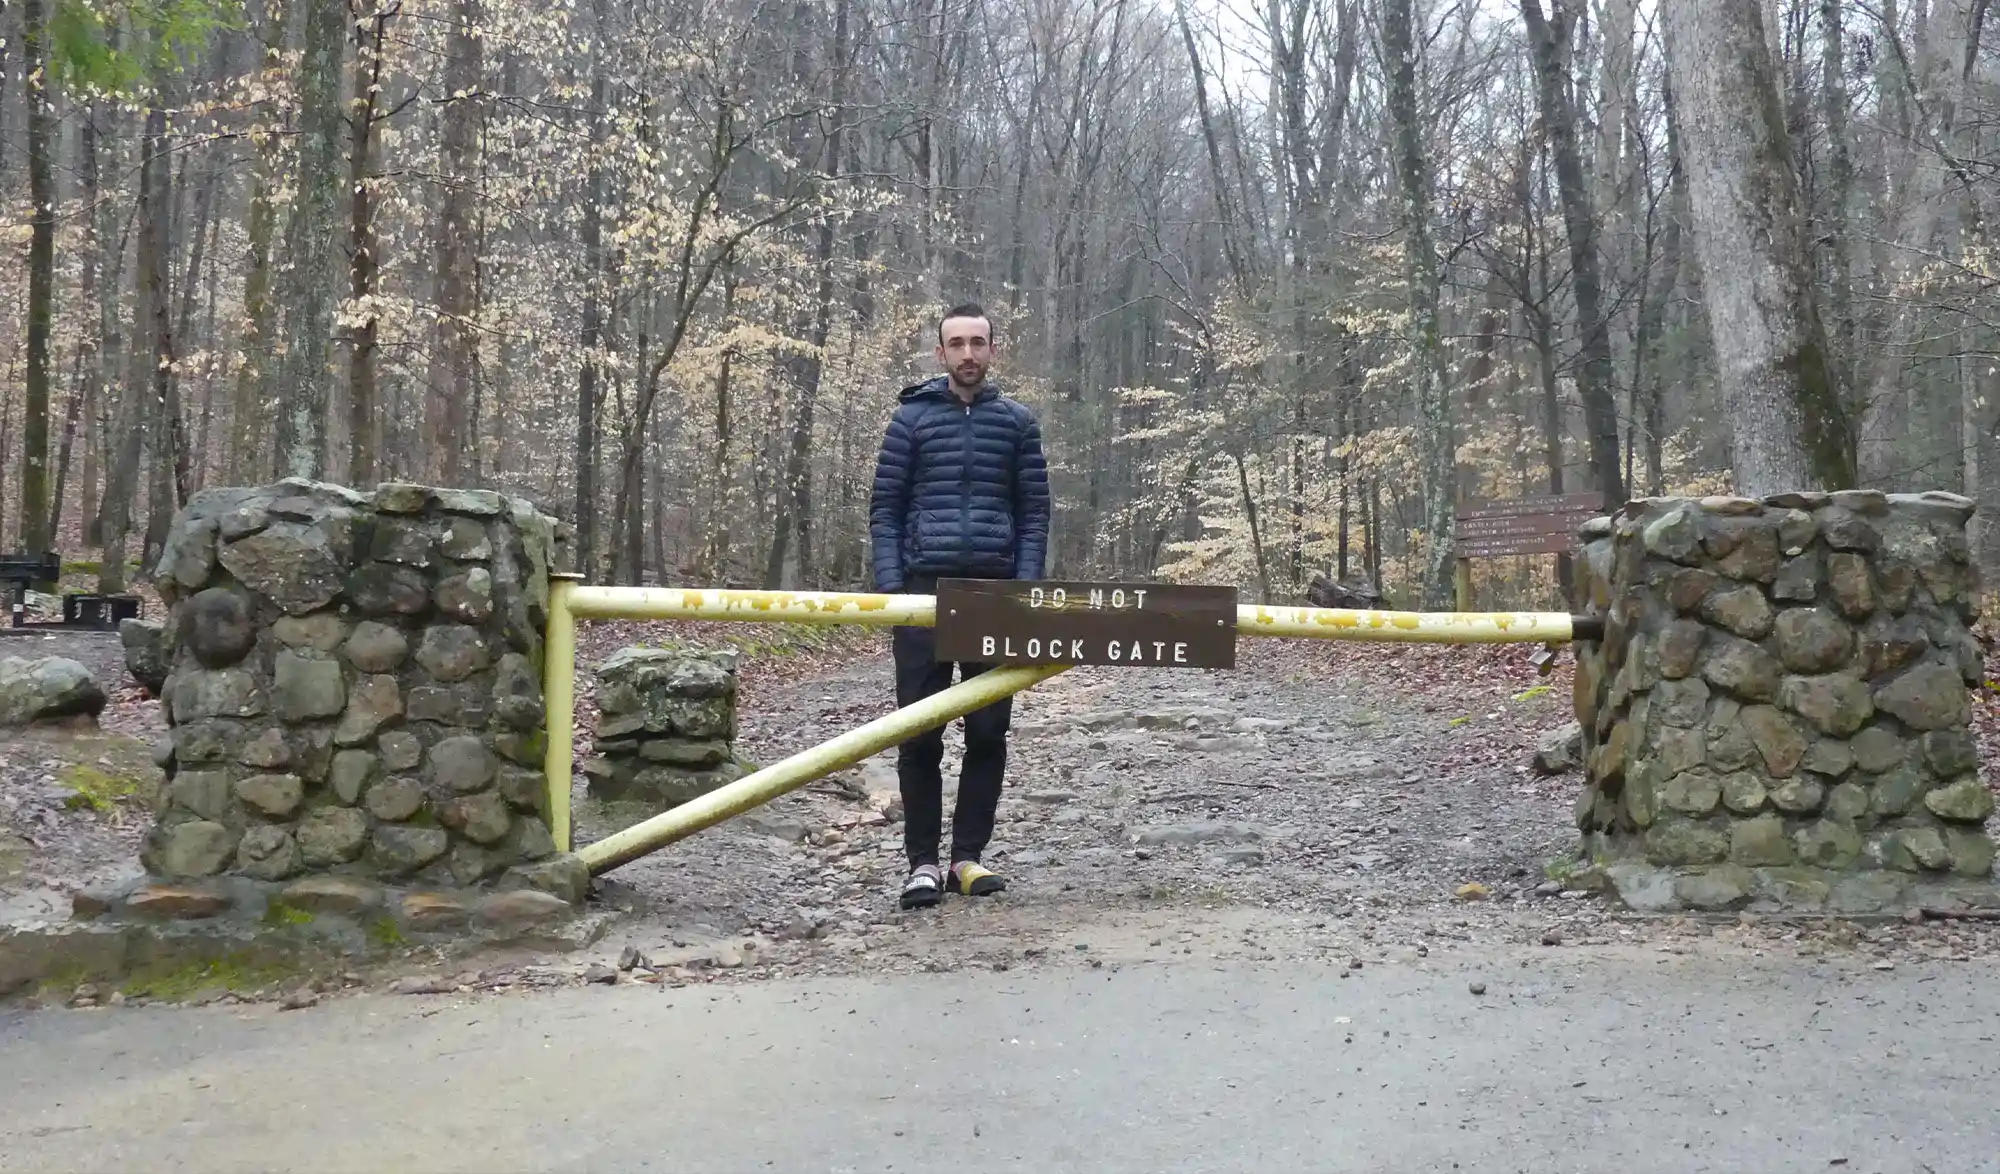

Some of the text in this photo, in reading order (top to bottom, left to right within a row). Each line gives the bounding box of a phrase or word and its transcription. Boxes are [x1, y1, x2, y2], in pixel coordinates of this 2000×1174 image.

[1030, 587, 1148, 610] DO NOT
[982, 635, 1188, 662] BLOCK GATE
